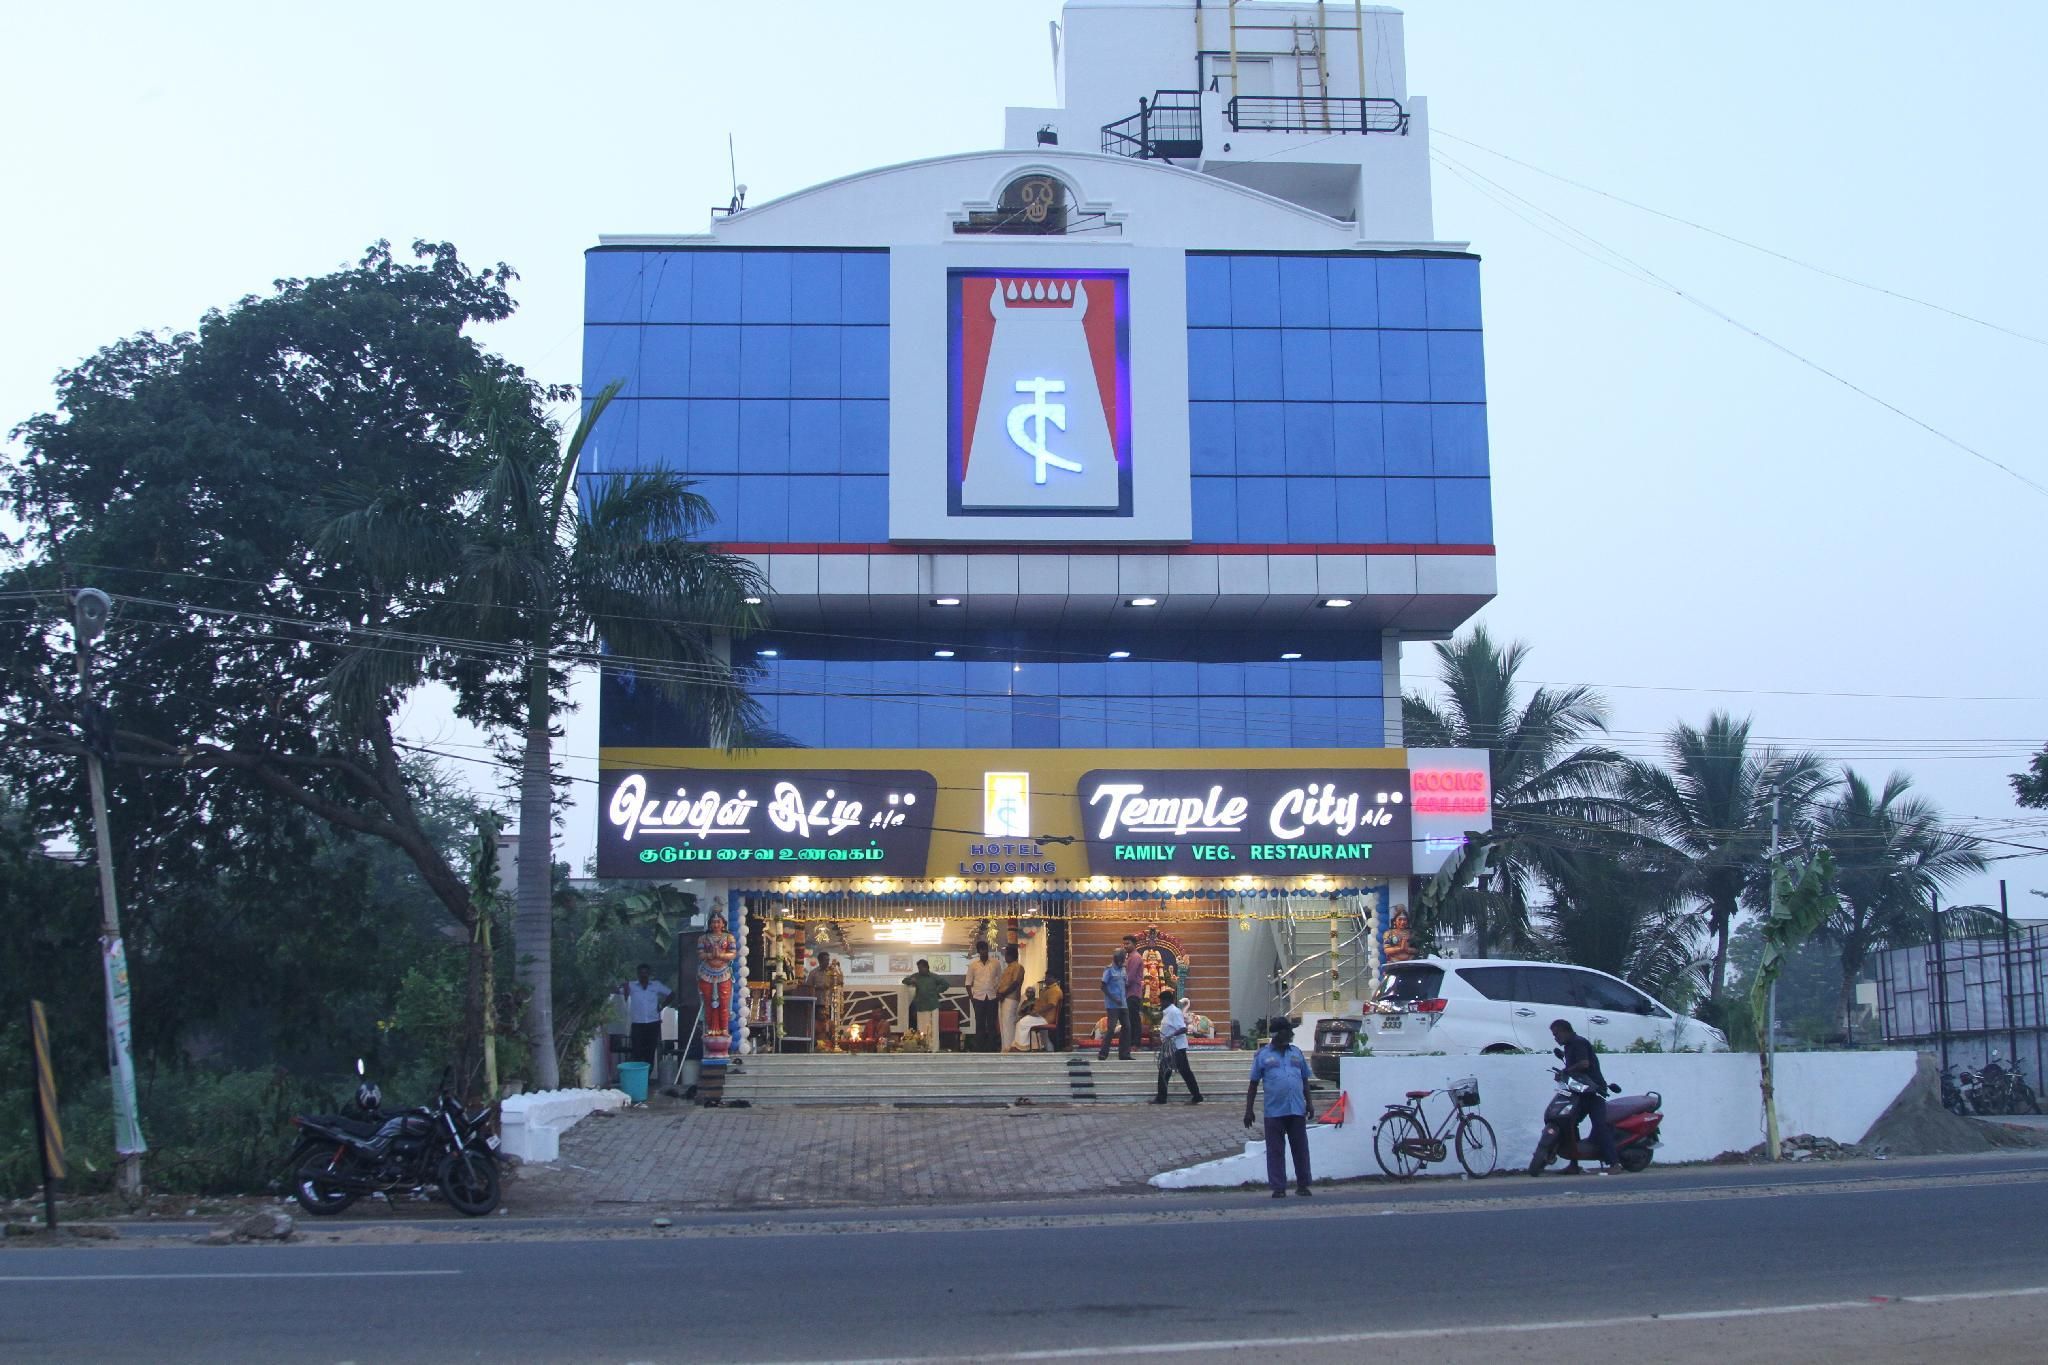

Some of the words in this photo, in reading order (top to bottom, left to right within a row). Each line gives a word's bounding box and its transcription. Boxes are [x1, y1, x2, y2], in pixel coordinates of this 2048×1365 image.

[1413, 772, 1484, 791] ROOMS
[610, 774, 758, 841] டெம்பிள்
[768, 782, 863, 838] சிட்டி
[1090, 784, 1248, 839] Temple
[1270, 783, 1359, 839] City
[639, 841, 711, 862] குடும்ப
[717, 848, 774, 861] சைவ
[779, 840, 884, 861] உணவகம்
[970, 844, 1043, 856] HOTEL
[1115, 845, 1176, 860] FAMILY
[1192, 845, 1236, 860] VEG.
[1251, 844, 1373, 860] RESTAURANT
[959, 861, 1056, 874] LODGING
